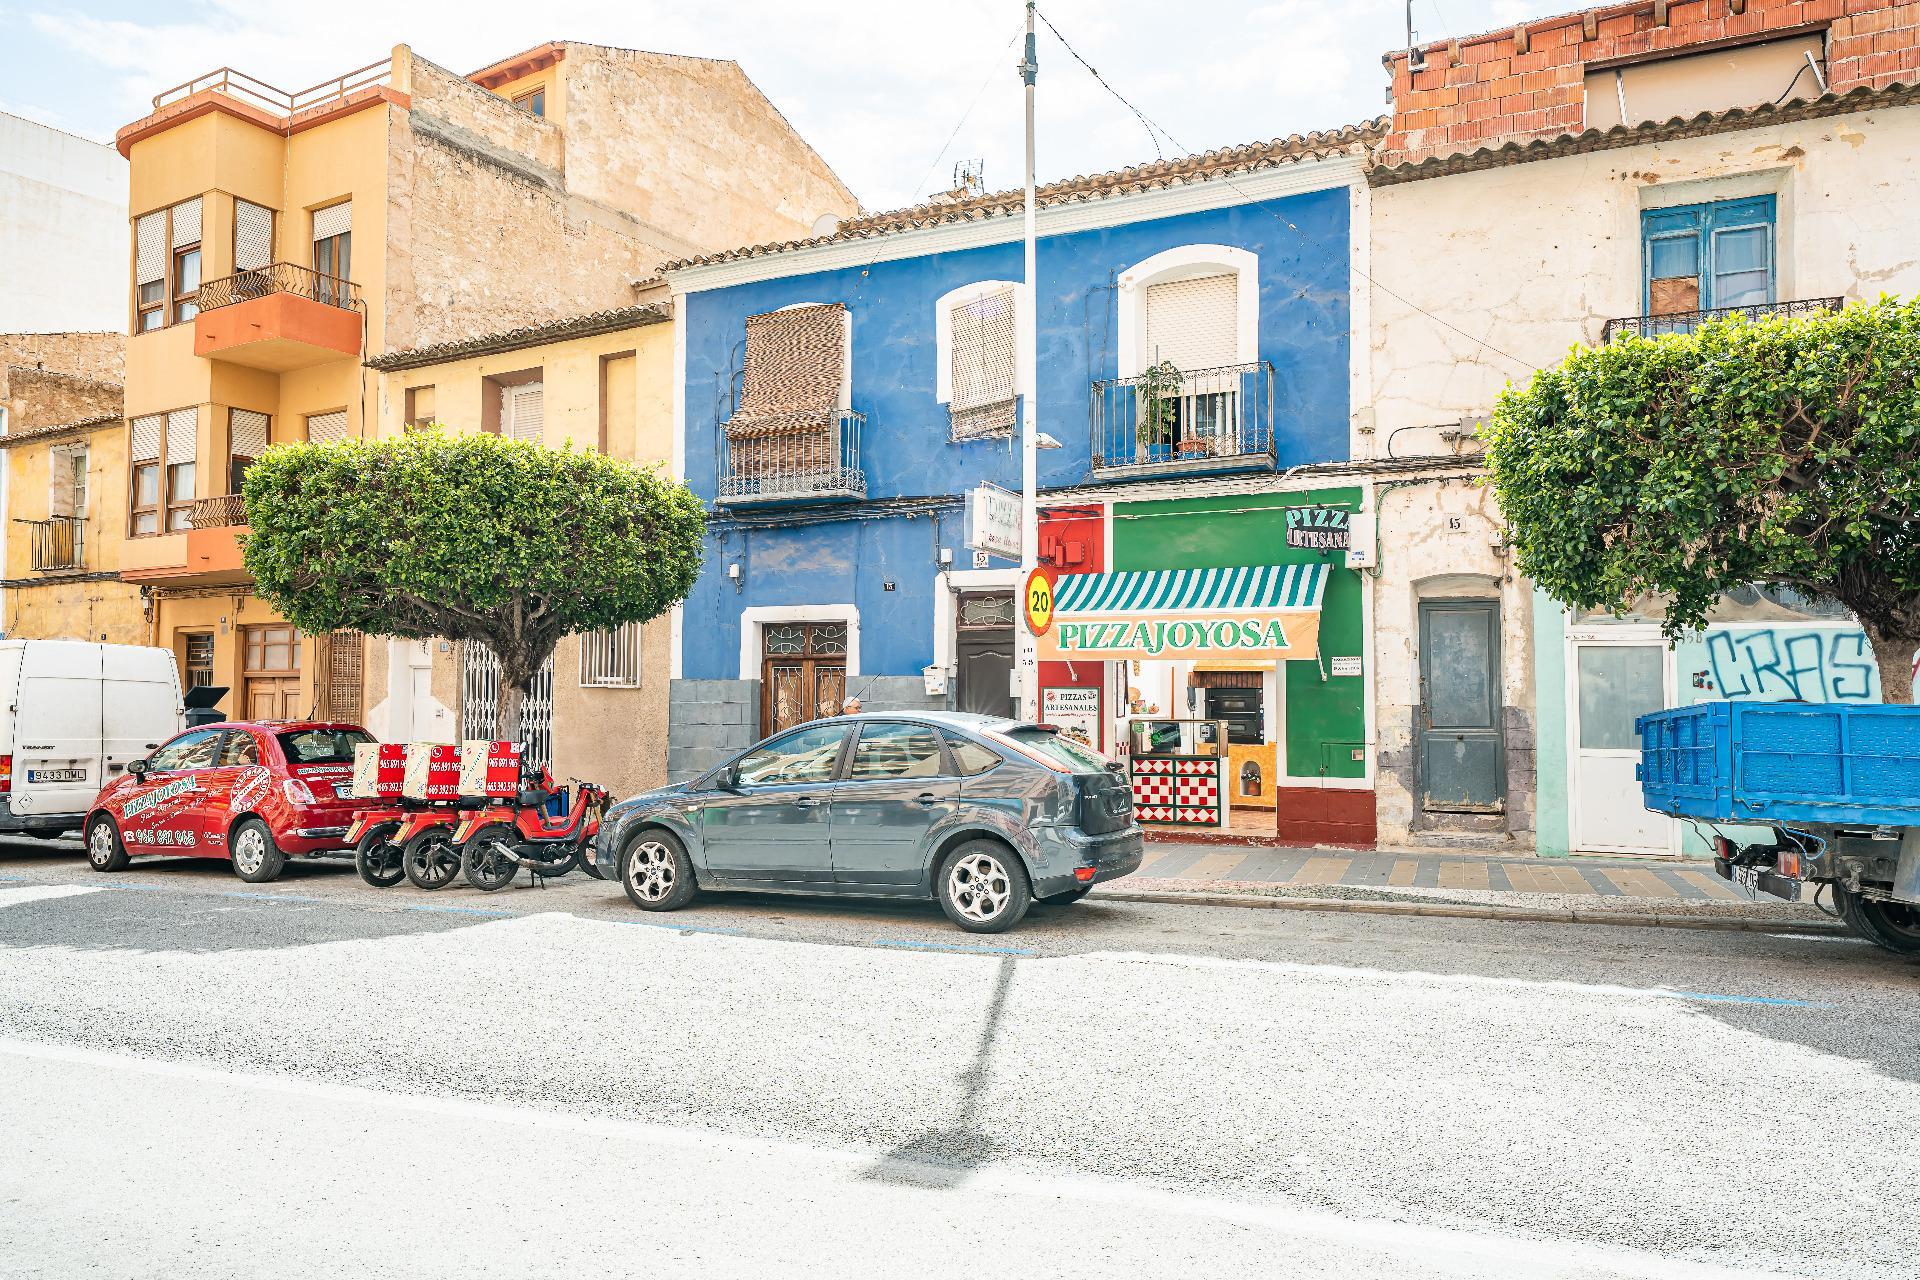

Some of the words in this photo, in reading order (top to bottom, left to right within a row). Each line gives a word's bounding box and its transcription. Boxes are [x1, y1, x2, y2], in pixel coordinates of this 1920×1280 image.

[1285, 508, 1350, 531] PIZZ
[1449, 517, 1461, 530] 15
[1031, 590, 1049, 613] 20
[1057, 620, 1290, 655] PIZZAJOYOSA
[1060, 693, 1087, 701] PIZZAS
[390, 759, 400, 769] 891
[488, 757, 498, 767] 965
[498, 758, 508, 767] 891
[508, 758, 518, 768] 965
[35, 771, 62, 780] 9433
[497, 781, 507, 791] 392
[136, 829, 155, 845] 965
[175, 830, 196, 846] 965
